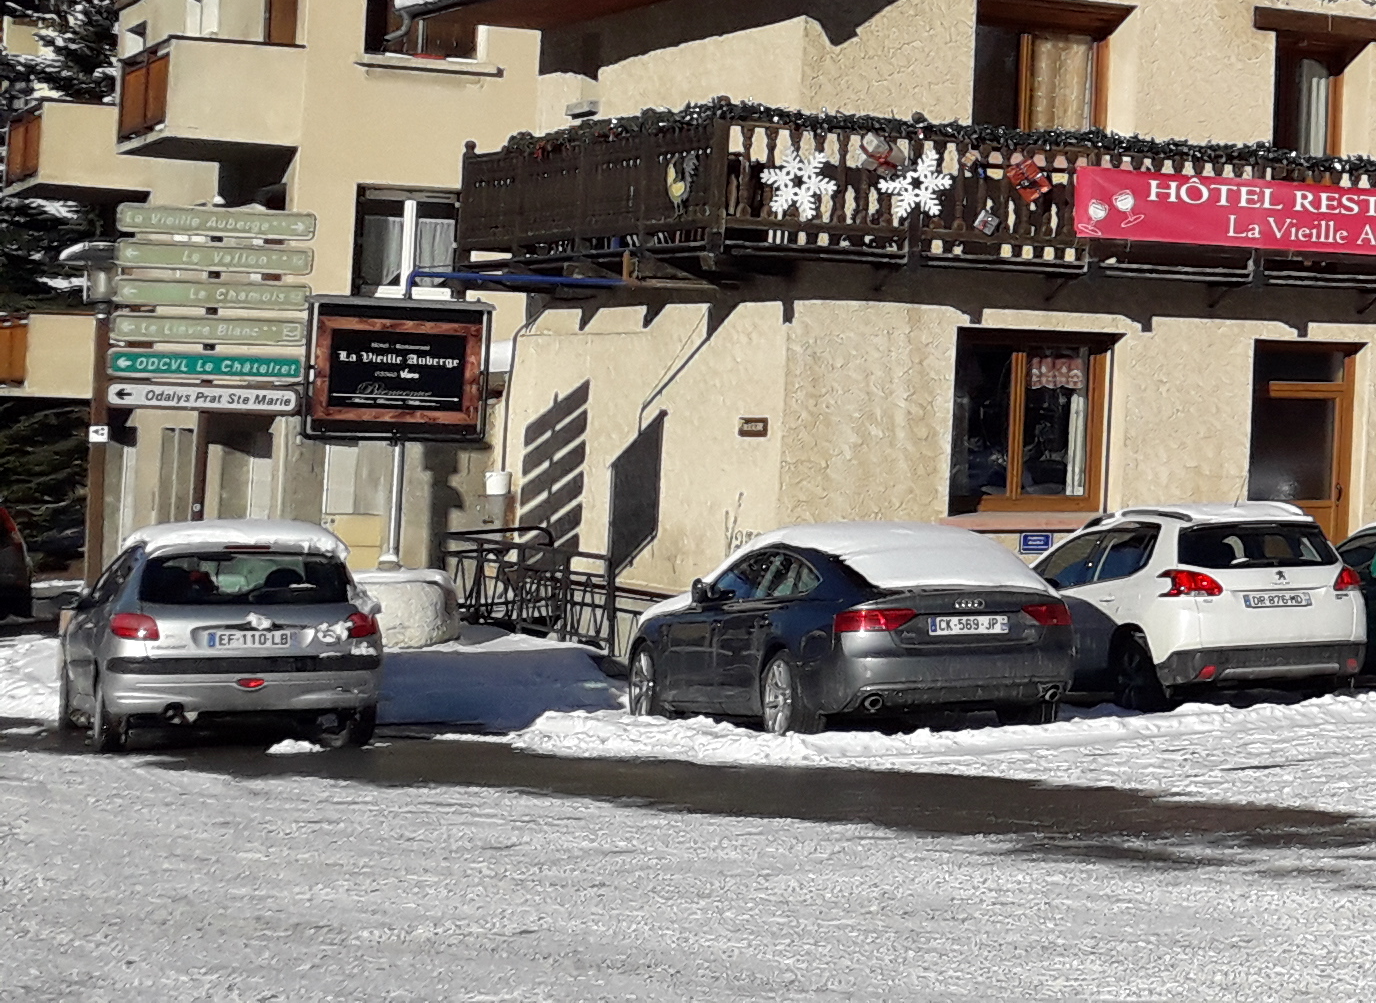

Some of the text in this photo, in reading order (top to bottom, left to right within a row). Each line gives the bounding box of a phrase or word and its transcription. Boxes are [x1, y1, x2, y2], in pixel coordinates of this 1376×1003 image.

[1147, 178, 1283, 210] HÔTEL
[151, 212, 200, 226] Vieille
[206, 216, 269, 233] Auberge
[1227, 215, 1261, 238] La
[1267, 217, 1349, 244] Vieille
[214, 251, 267, 265] Vallon
[217, 324, 259, 337] Blanc
[136, 357, 188, 371] ODCVL
[196, 359, 213, 372] Le
[337, 350, 460, 368] La Vieille Auberge
[145, 390, 292, 407] Odalys Prat Ste Marie
